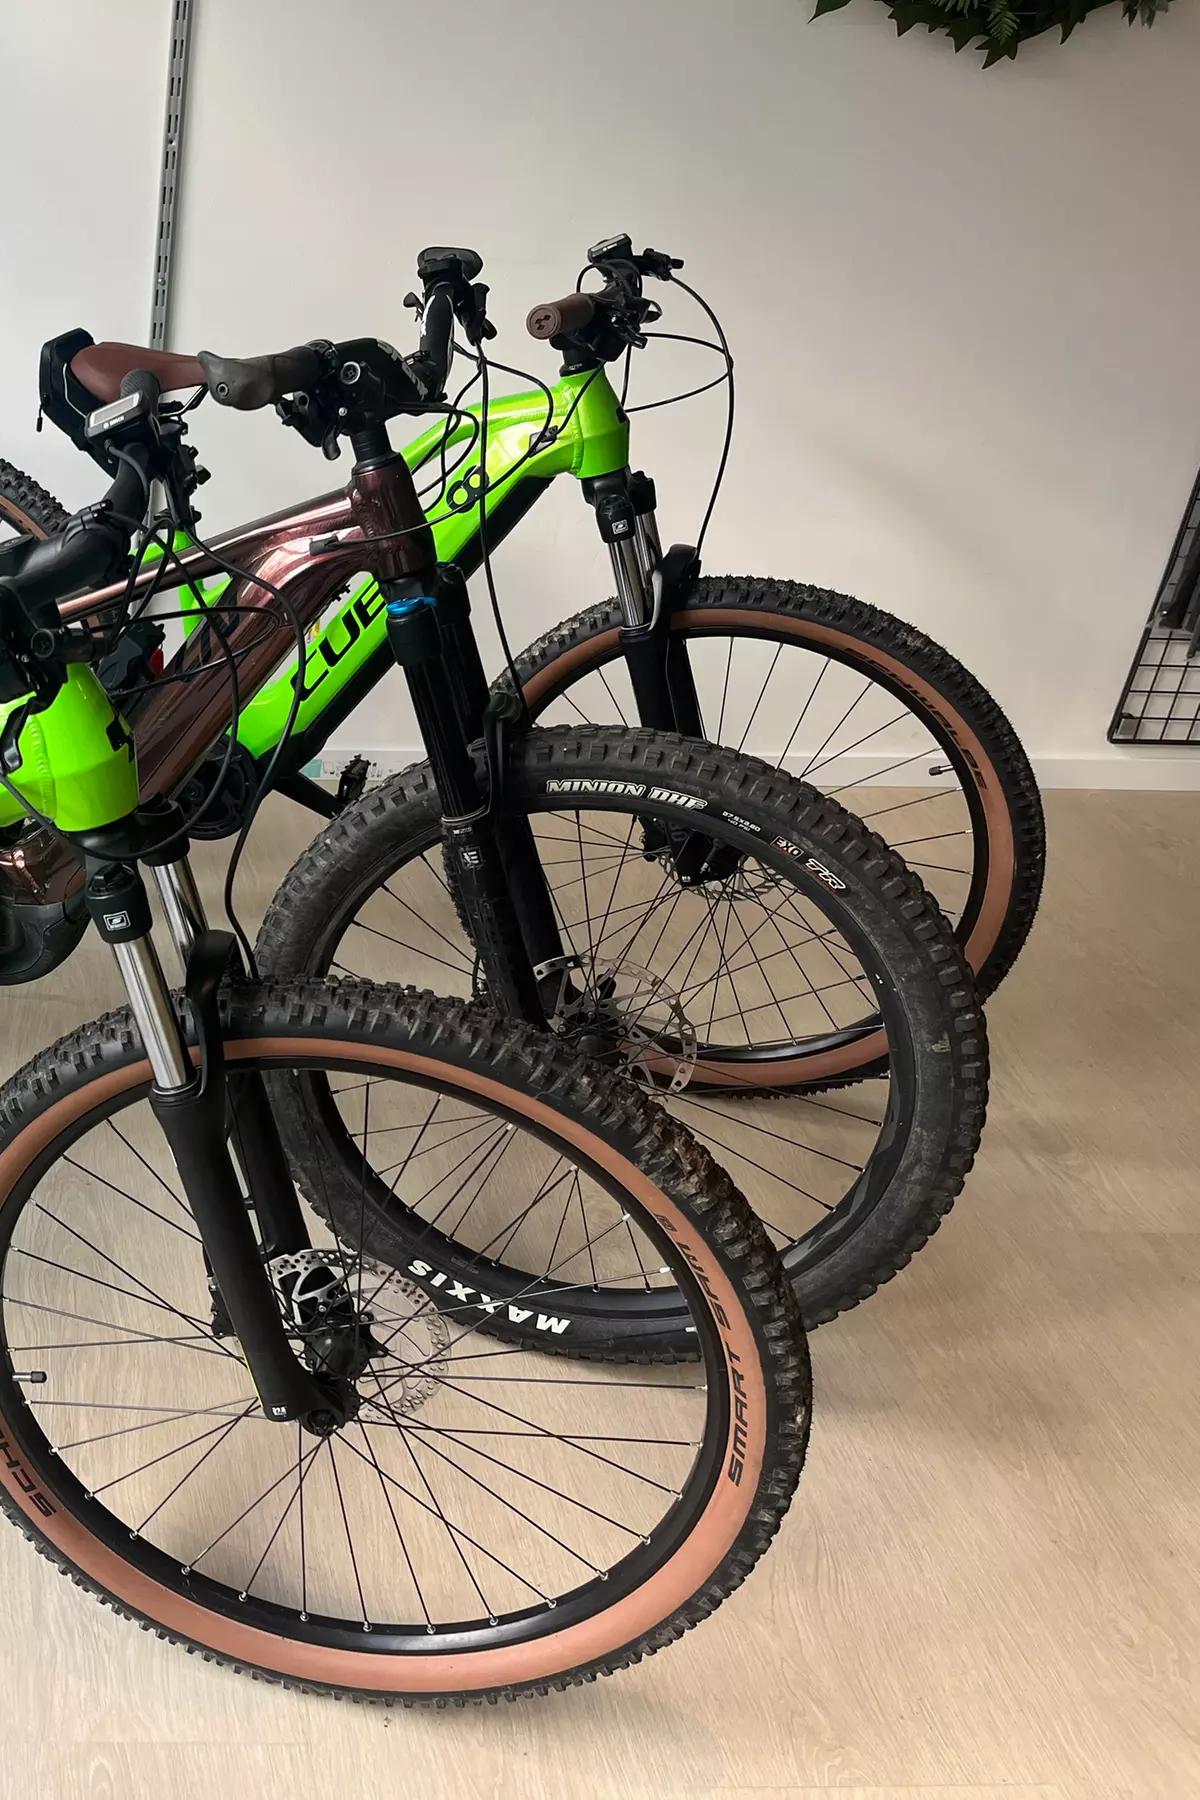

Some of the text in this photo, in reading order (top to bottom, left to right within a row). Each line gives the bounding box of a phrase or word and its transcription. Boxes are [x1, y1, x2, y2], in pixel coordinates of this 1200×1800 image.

[546, 779, 708, 810] MINION DHF
[407, 1259, 571, 1335] MAXXIS
[724, 1341, 749, 1488] SMART
